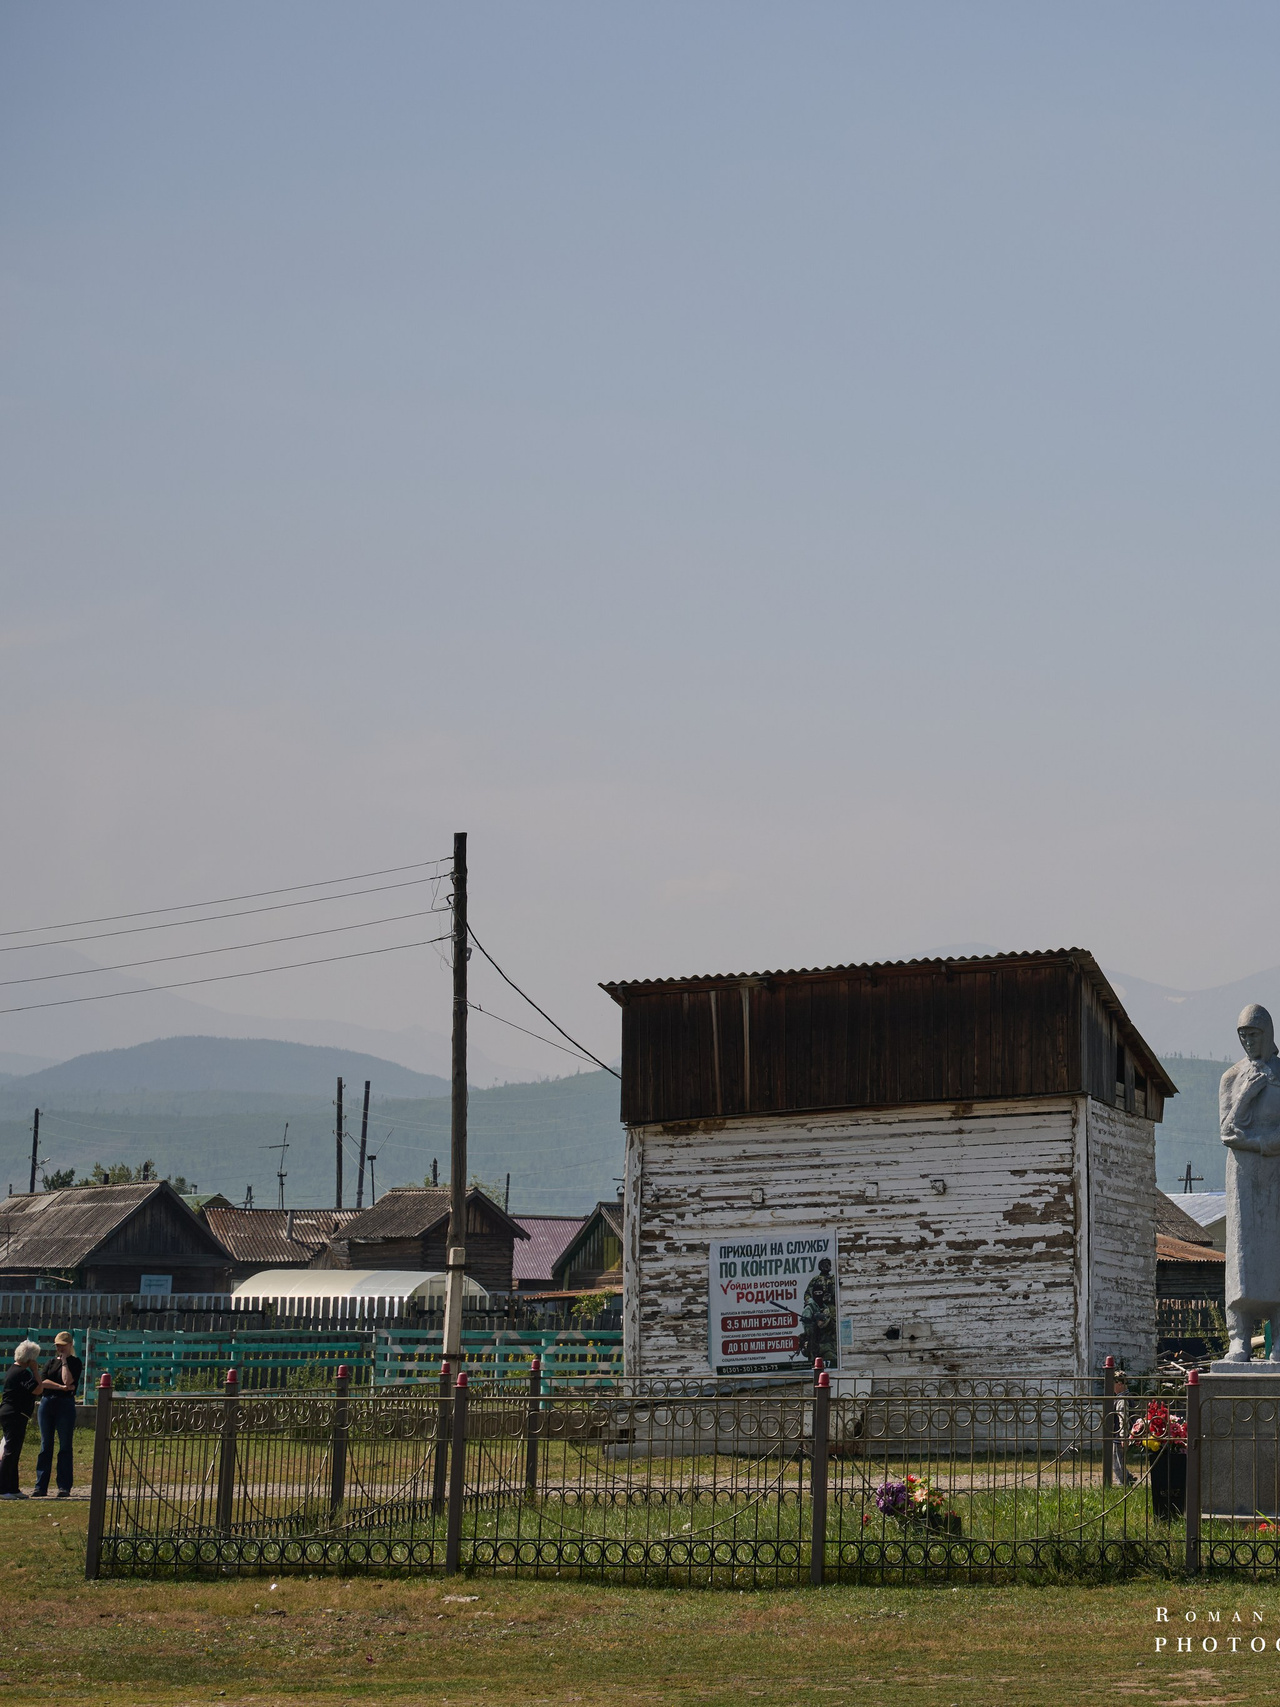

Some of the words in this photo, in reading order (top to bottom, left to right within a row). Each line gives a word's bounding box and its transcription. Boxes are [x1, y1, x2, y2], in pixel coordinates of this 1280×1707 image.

[720, 1244, 767, 1259] ПРИХОДИ
[770, 1242, 783, 1256] НА
[786, 1239, 829, 1255] СЛУЖБУ
[719, 1261, 737, 1279] ПО
[741, 1256, 817, 1278] КОНТРАКТУ
[759, 1280, 797, 1289] ИСТОРИЮ
[736, 1288, 797, 1304] РОДИНЫ
[726, 1319, 739, 1330] 3,5
[741, 1318, 760, 1328] МЛН
[761, 1314, 793, 1327] РУБЛЕЙ
[727, 1343, 738, 1354] ДО
[740, 1342, 748, 1351] 10
[750, 1341, 765, 1351] МЛН
[767, 1337, 793, 1350] РУБЛЕЙ
